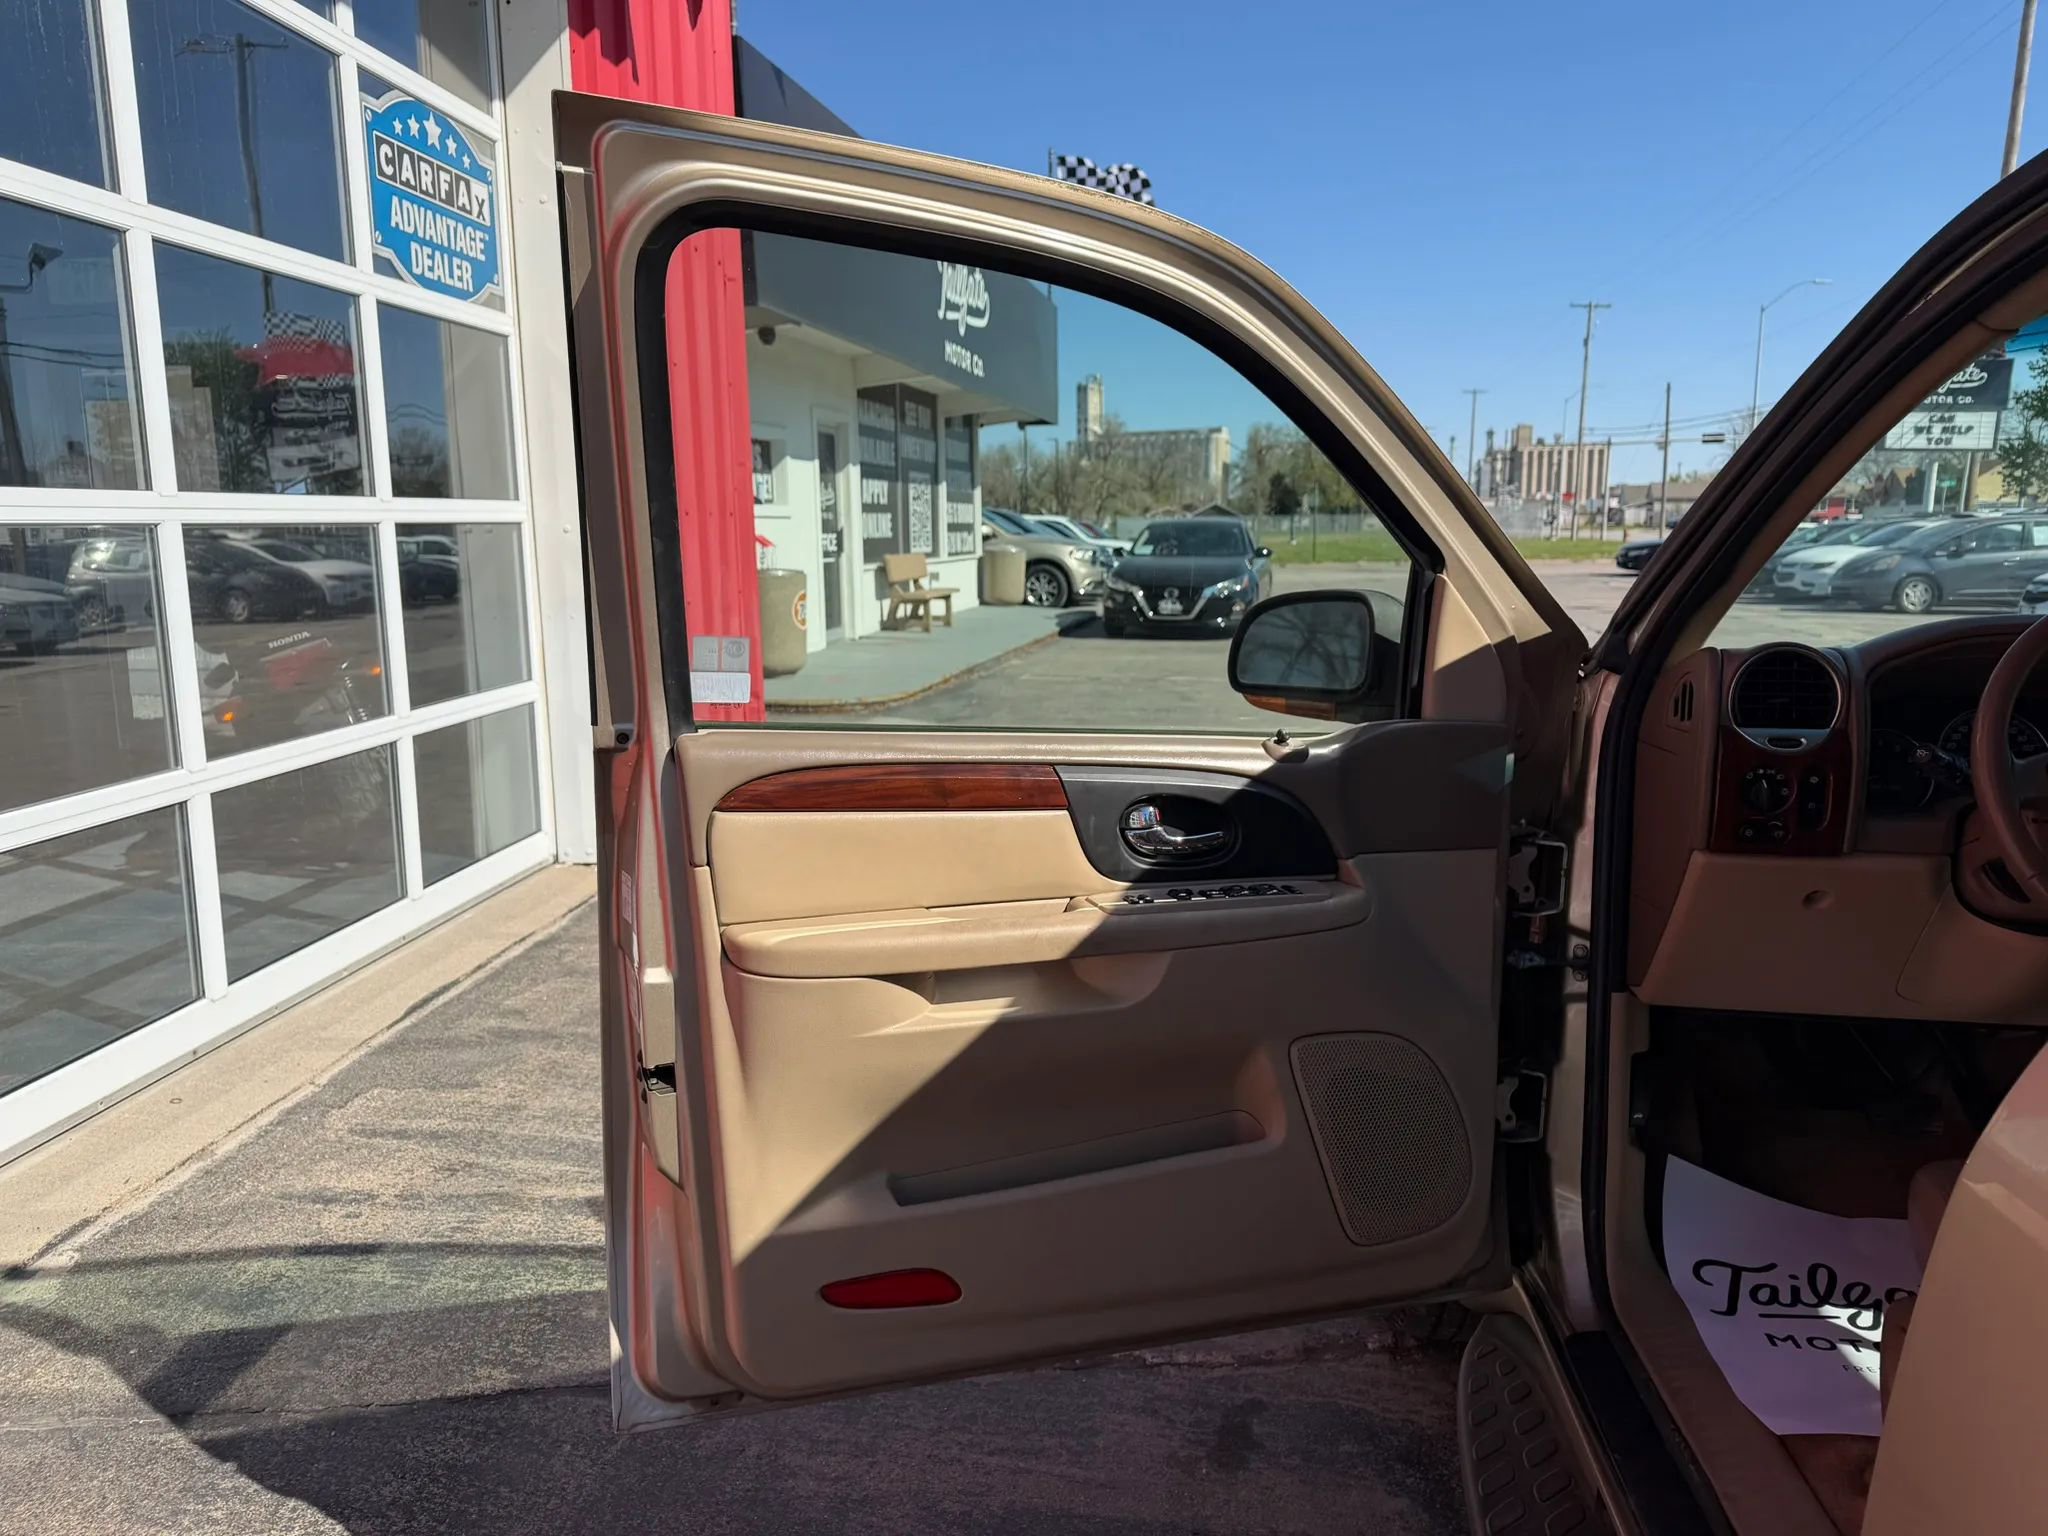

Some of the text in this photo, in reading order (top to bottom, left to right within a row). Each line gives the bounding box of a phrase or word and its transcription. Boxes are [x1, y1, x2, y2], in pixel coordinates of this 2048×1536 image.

[378, 143, 486, 222] CARFAX
[390, 195, 486, 262] ADVANTAGE
[410, 241, 474, 293] DEALER
[945, 339, 972, 374] MOTOR
[1924, 395, 1953, 404] OTOR
[1929, 414, 1955, 424] CAN
[1914, 425, 1974, 436] WE HELP
[1926, 437, 1953, 446] YOU
[862, 478, 888, 505] APPLY
[268, 631, 311, 648] HONDA
[1842, 1364, 1880, 1375] FRE
